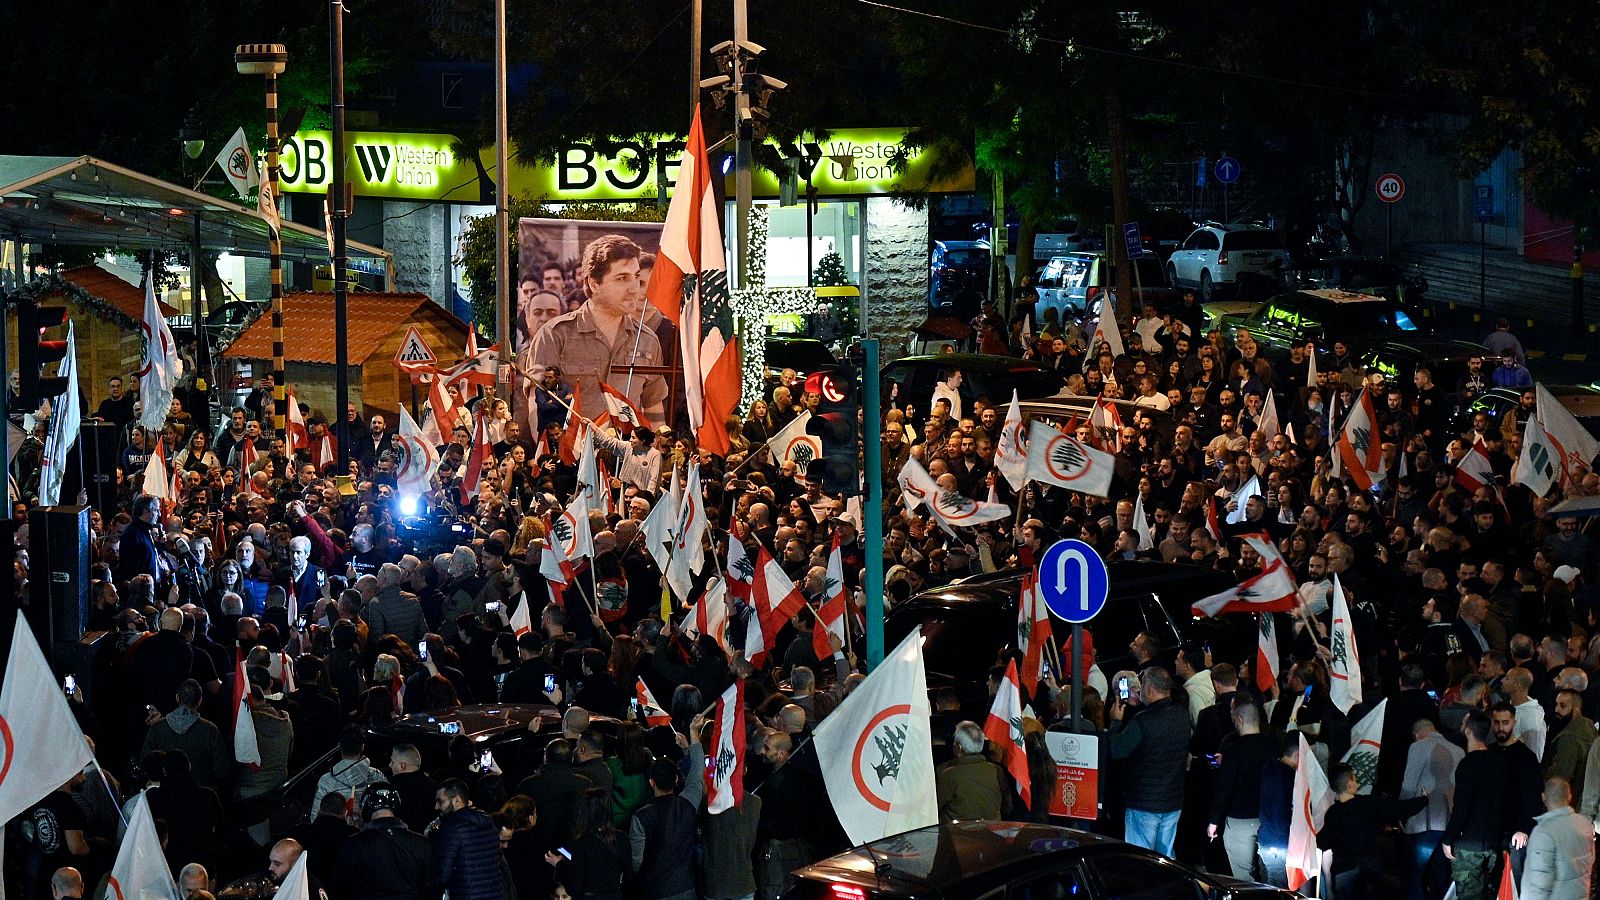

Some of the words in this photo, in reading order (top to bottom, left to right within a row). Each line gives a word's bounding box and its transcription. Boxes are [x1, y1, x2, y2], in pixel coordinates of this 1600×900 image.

[395, 145, 447, 165] Western
[395, 167, 432, 185] Union
[1382, 182, 1398, 193] 40
